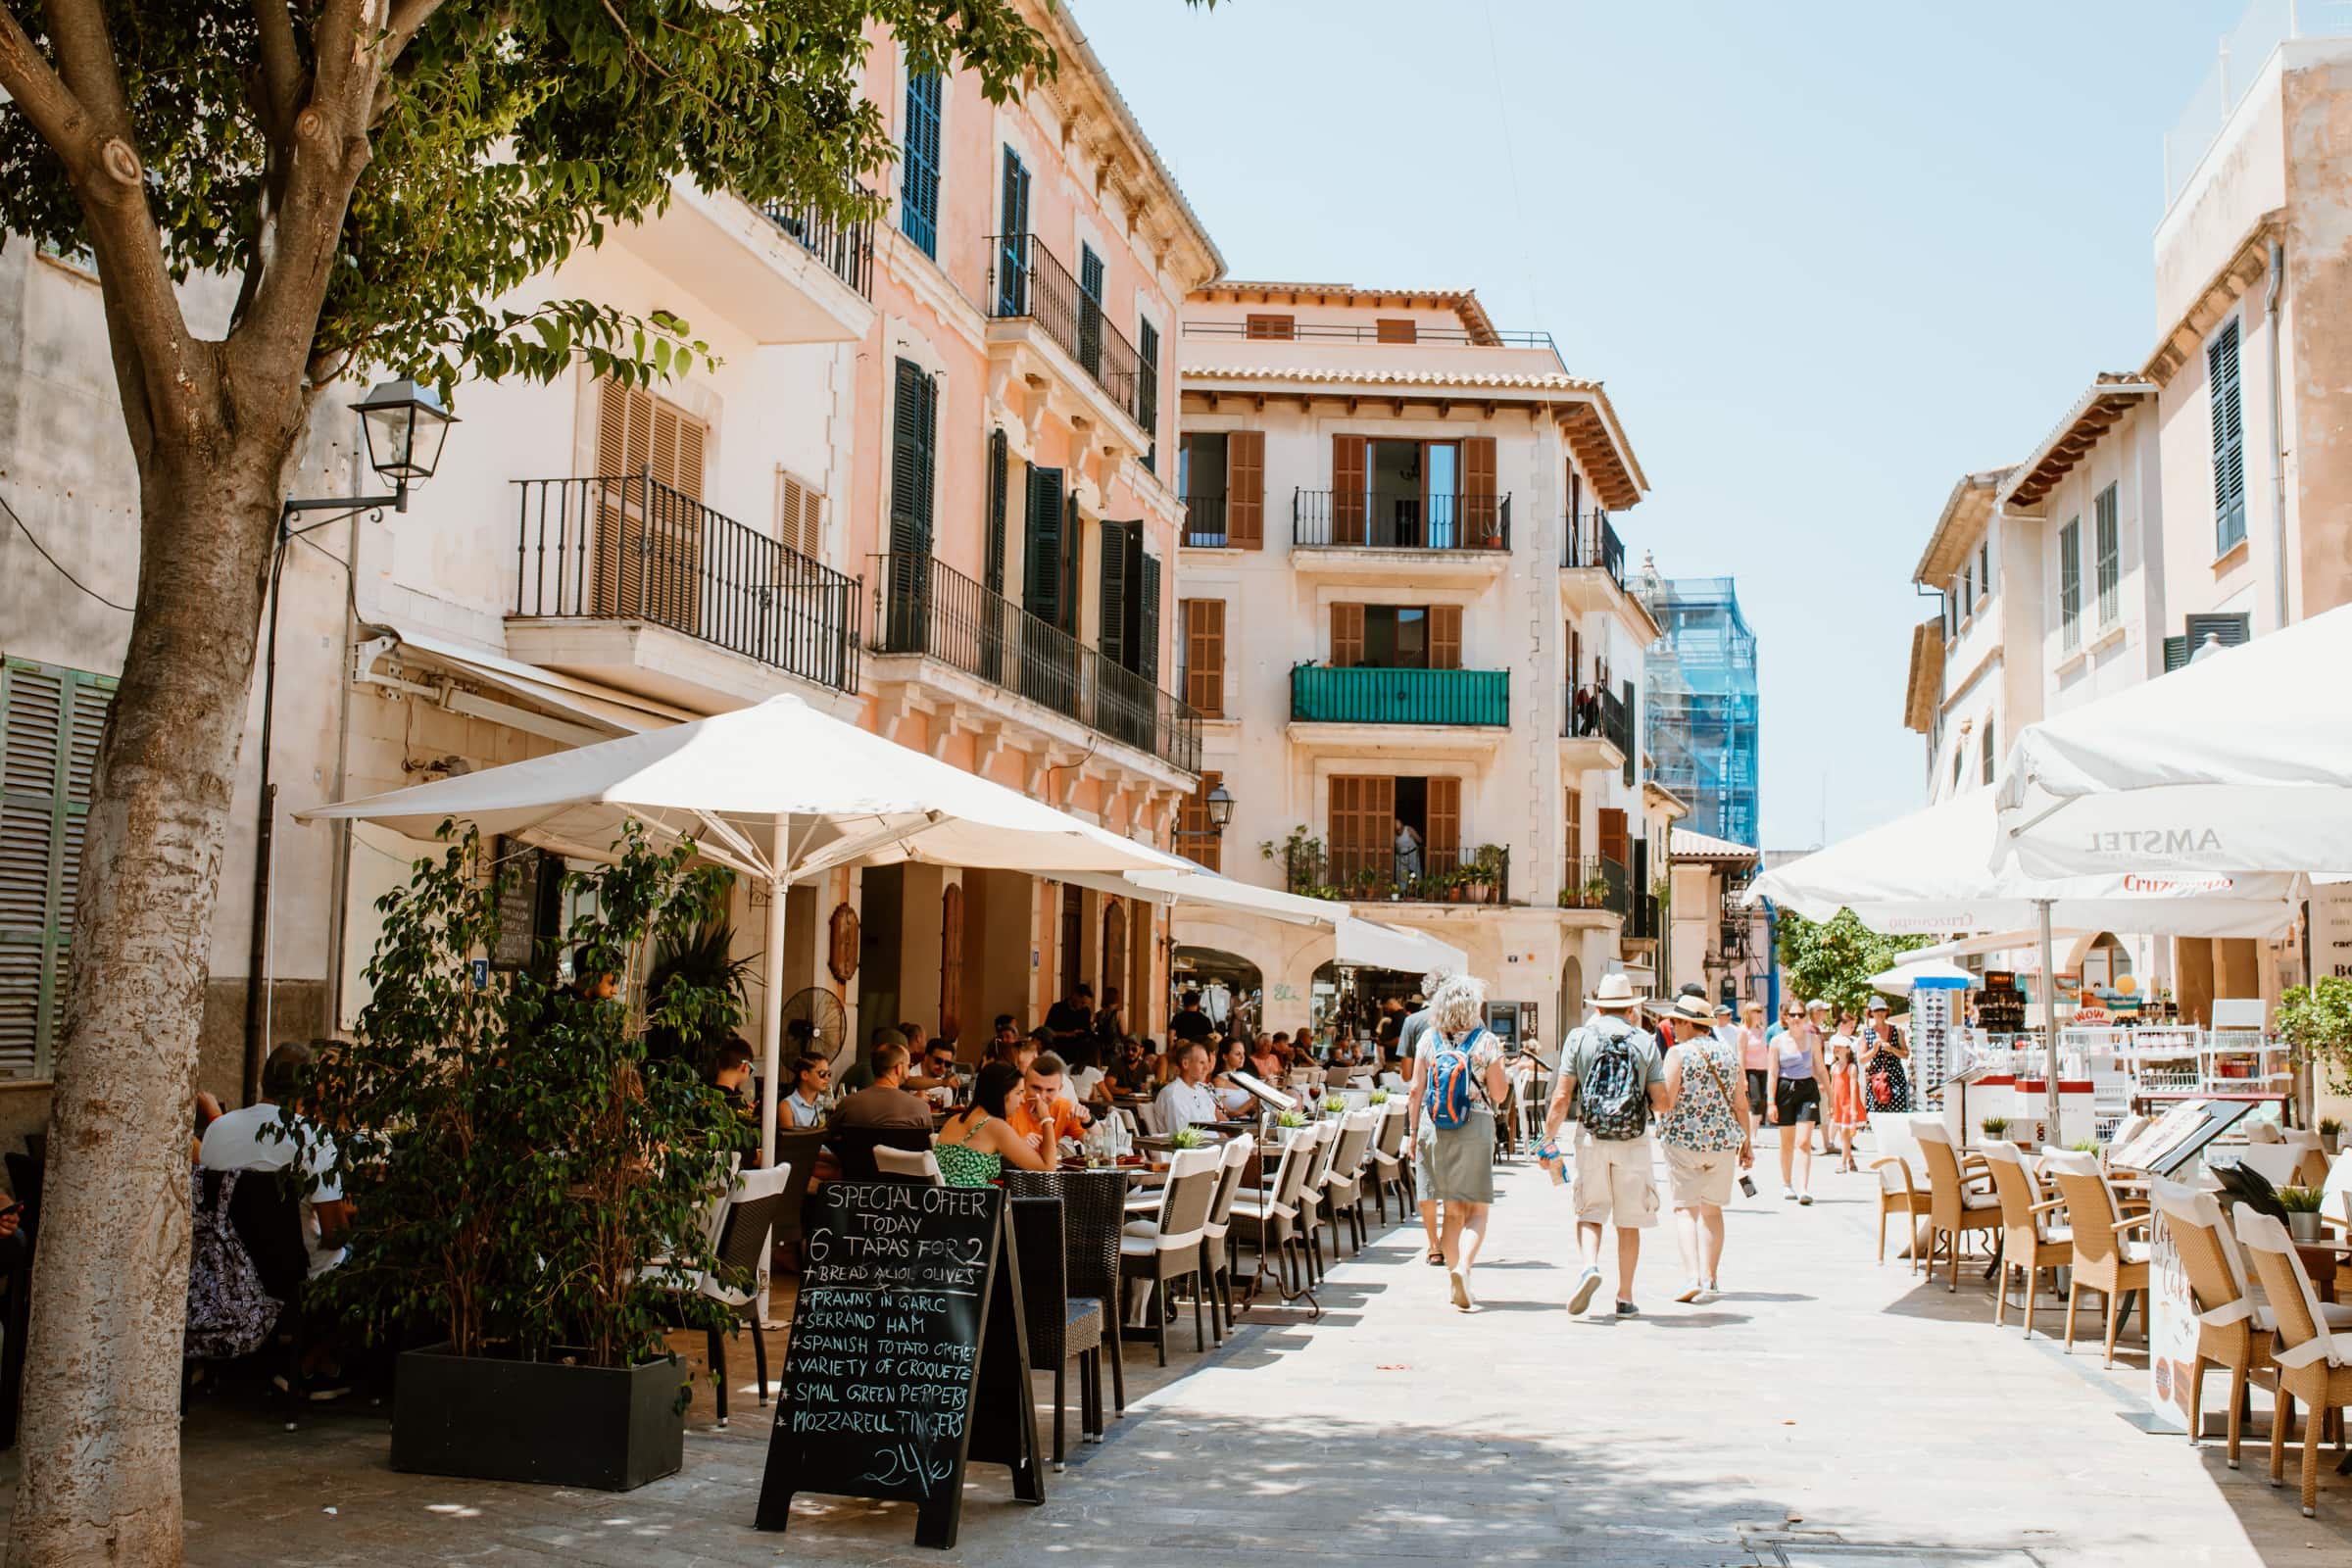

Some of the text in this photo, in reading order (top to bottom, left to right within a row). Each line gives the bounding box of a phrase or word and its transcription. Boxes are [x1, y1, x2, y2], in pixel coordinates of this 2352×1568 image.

[475, 963, 483, 981] R
[2073, 1009, 2105, 1022] WOW
[827, 1185, 987, 1218] SPECIAL OFFER
[856, 1213, 921, 1235] TODAY
[809, 1227, 988, 1267] 6 TAPAS FOR 2
[922, 1267, 974, 1285] OLIVES
[810, 1291, 872, 1310] PRAWNS
[881, 1294, 893, 1307] IN
[805, 1311, 925, 1334] SERRANO HAM
[803, 1335, 868, 1354] SPANISH
[798, 1356, 868, 1378] VARIETY
[875, 1359, 895, 1375] OF
[846, 1384, 896, 1403] GREEN
[900, 1384, 966, 1410] PEPPERS
